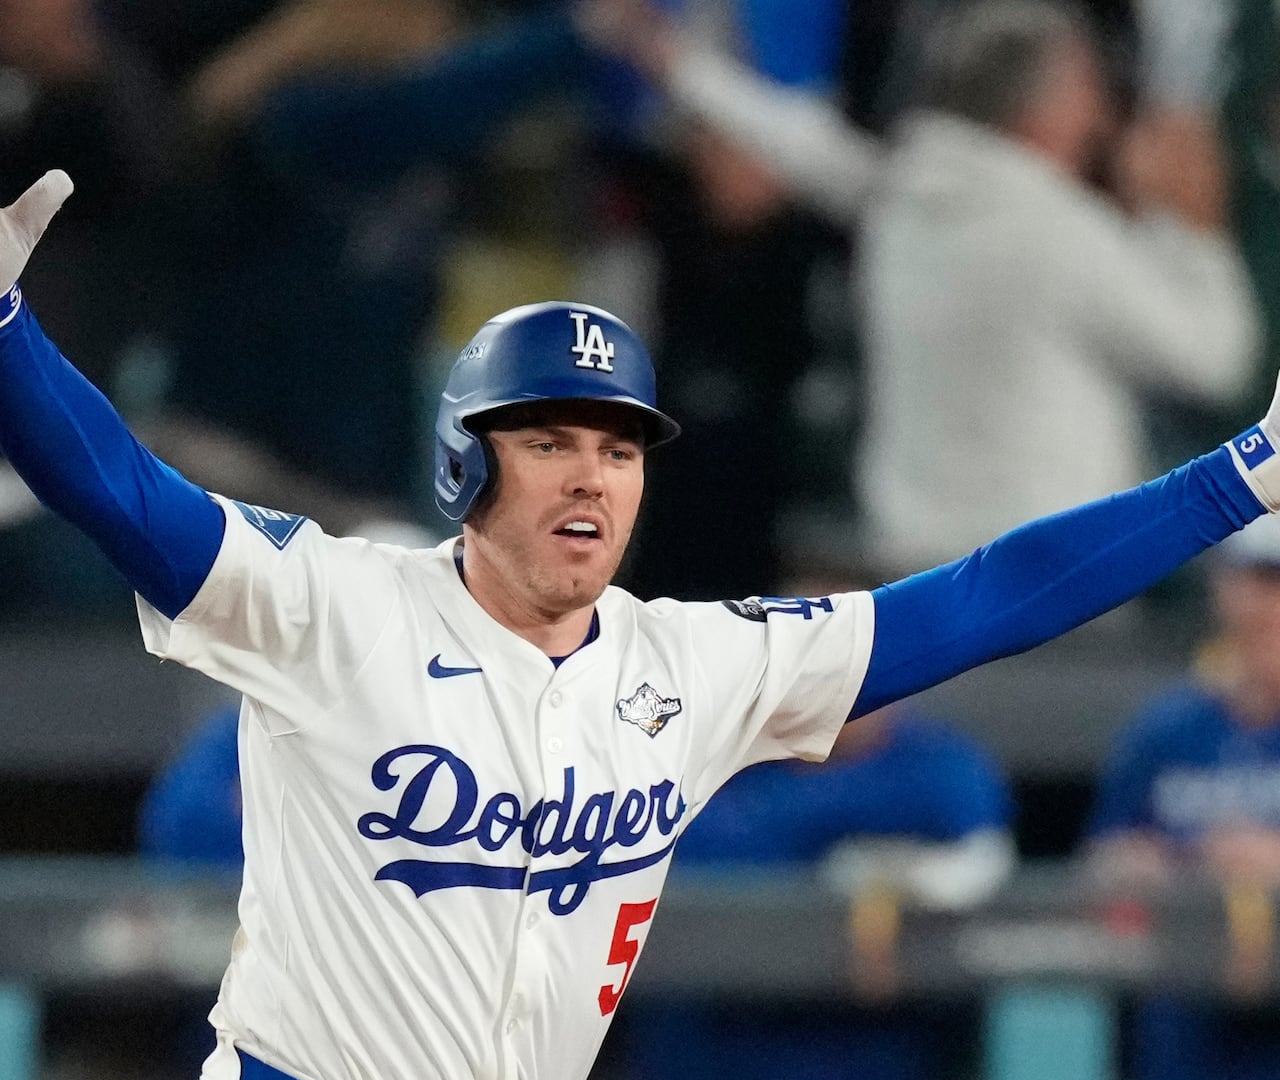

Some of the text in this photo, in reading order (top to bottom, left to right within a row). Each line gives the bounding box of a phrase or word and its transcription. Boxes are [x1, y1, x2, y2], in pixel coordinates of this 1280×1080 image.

[569, 312, 615, 372] LA
[1240, 433, 1263, 453] 5
[357, 743, 687, 916] Dodger
[597, 897, 658, 1017] 5
